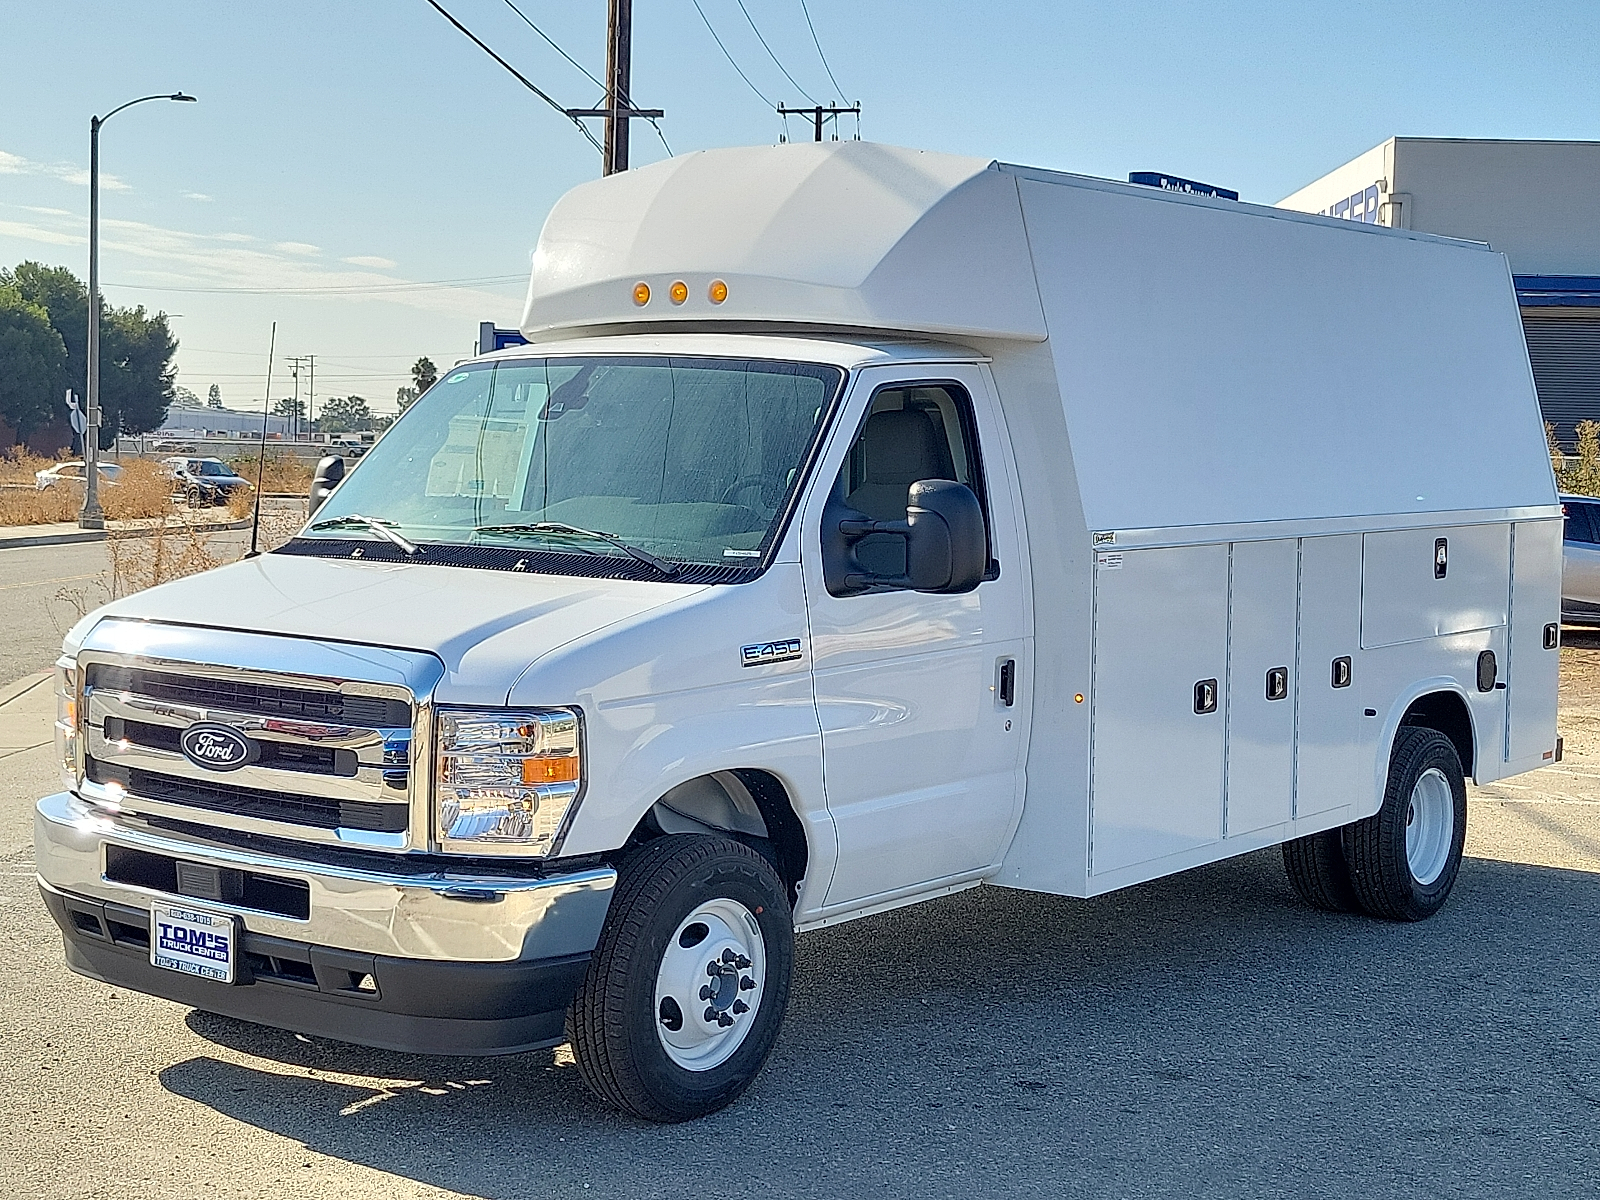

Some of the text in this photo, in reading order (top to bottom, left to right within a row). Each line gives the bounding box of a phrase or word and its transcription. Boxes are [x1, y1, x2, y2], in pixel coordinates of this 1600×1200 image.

[743, 642, 801, 660] E-450
[195, 733, 235, 760] Ford
[158, 922, 229, 952] TOM'S
[161, 939, 227, 961] TRUCK CENTER
[178, 962, 200, 975] TRUCK
[201, 966, 226, 980] CENTER
